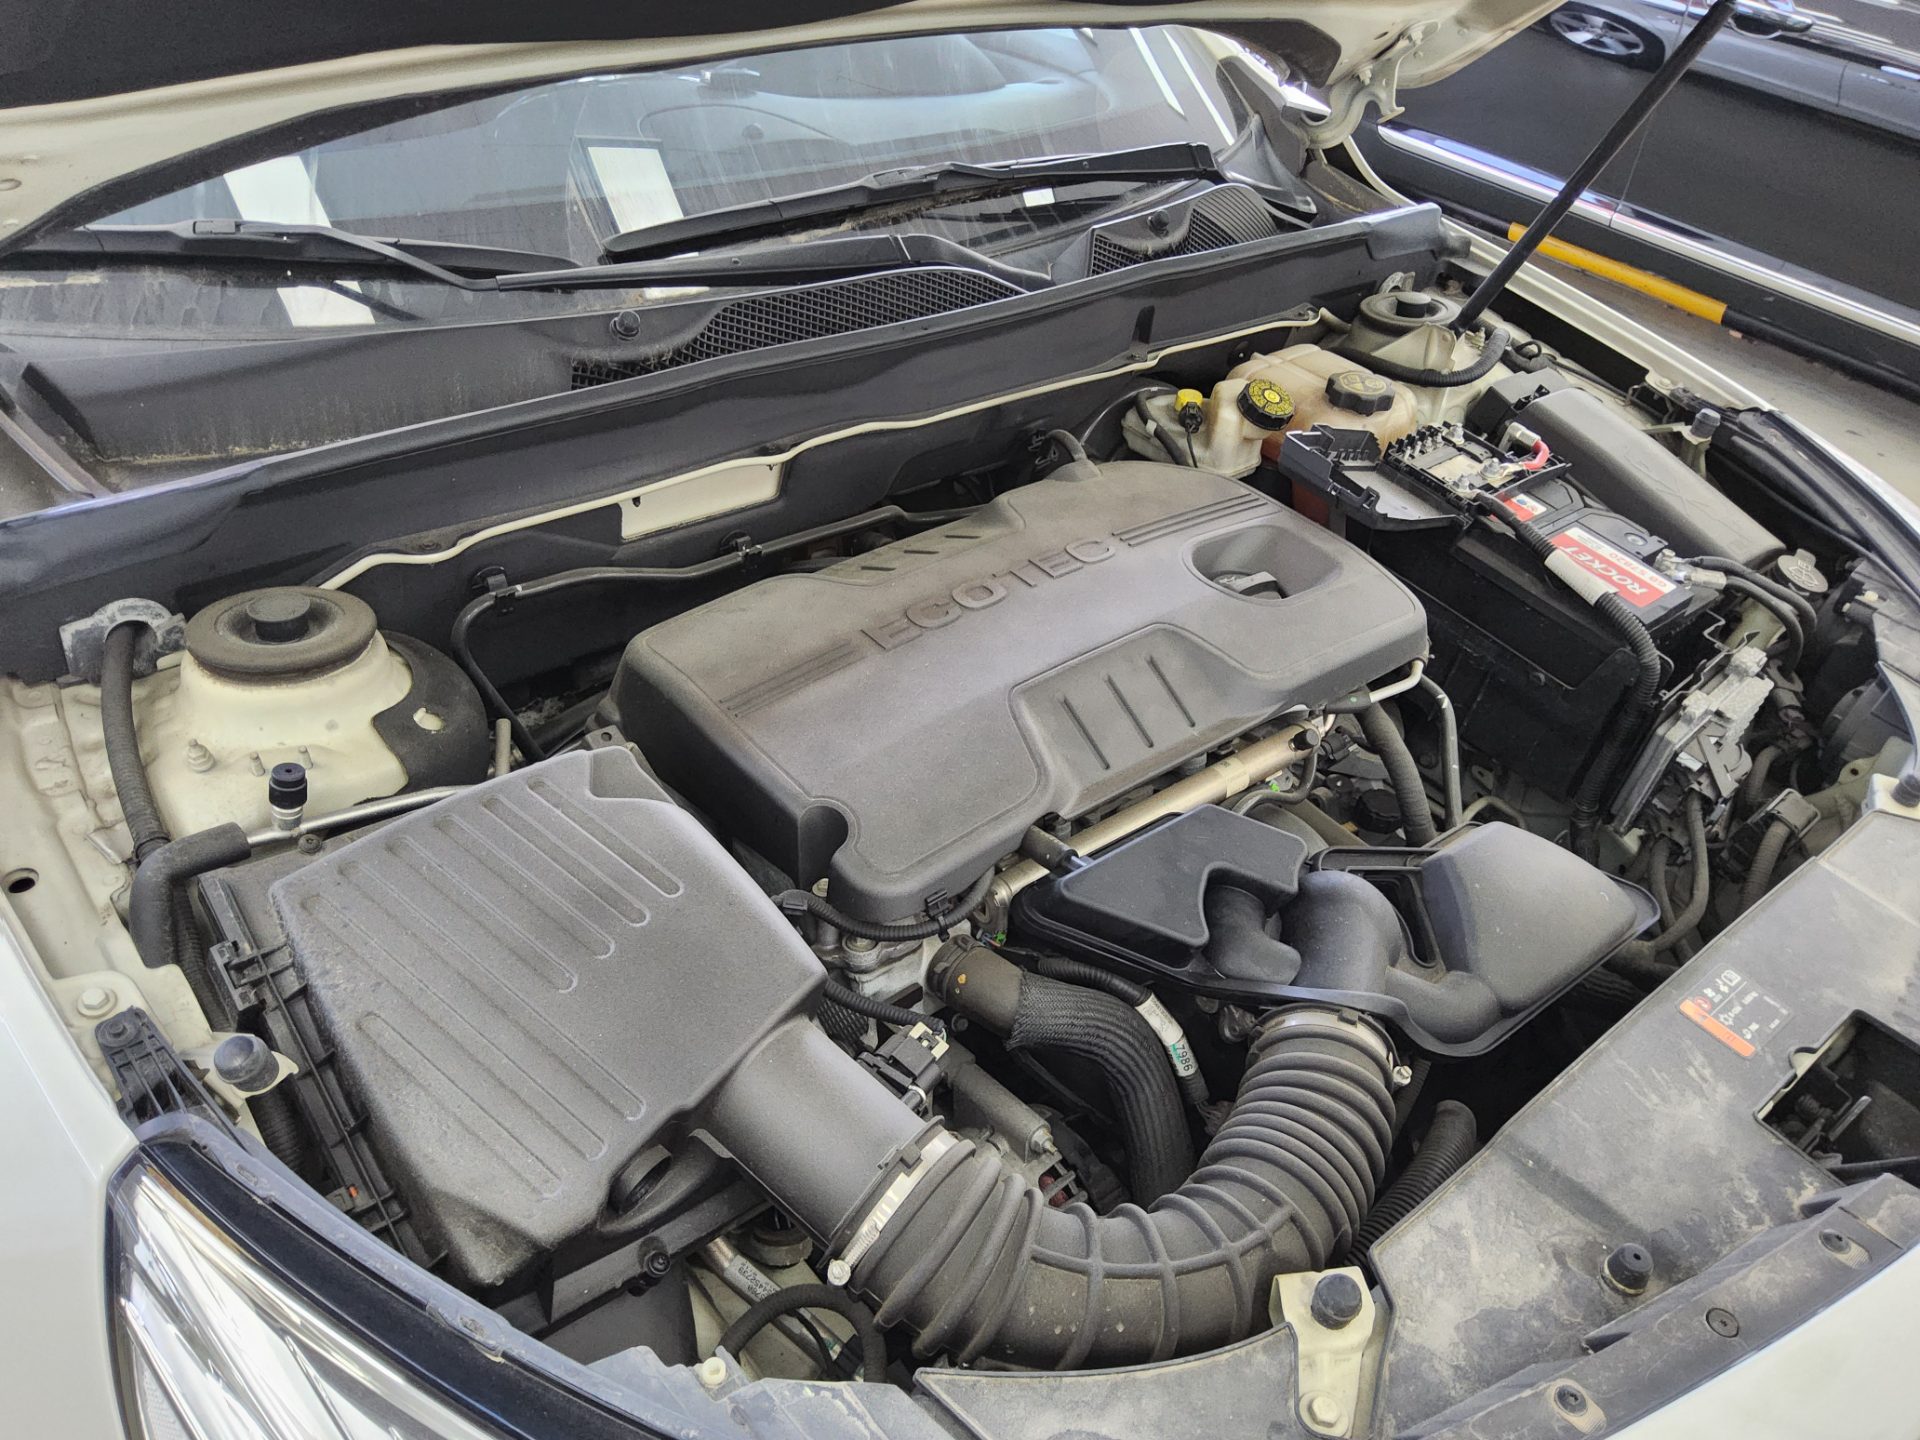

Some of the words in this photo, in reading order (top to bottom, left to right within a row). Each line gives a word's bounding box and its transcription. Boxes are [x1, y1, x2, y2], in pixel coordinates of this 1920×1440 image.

[860, 538, 1116, 651] ECOTEC
[1559, 545, 1648, 595] ROCKET
[1175, 1043, 1194, 1072] 7986
